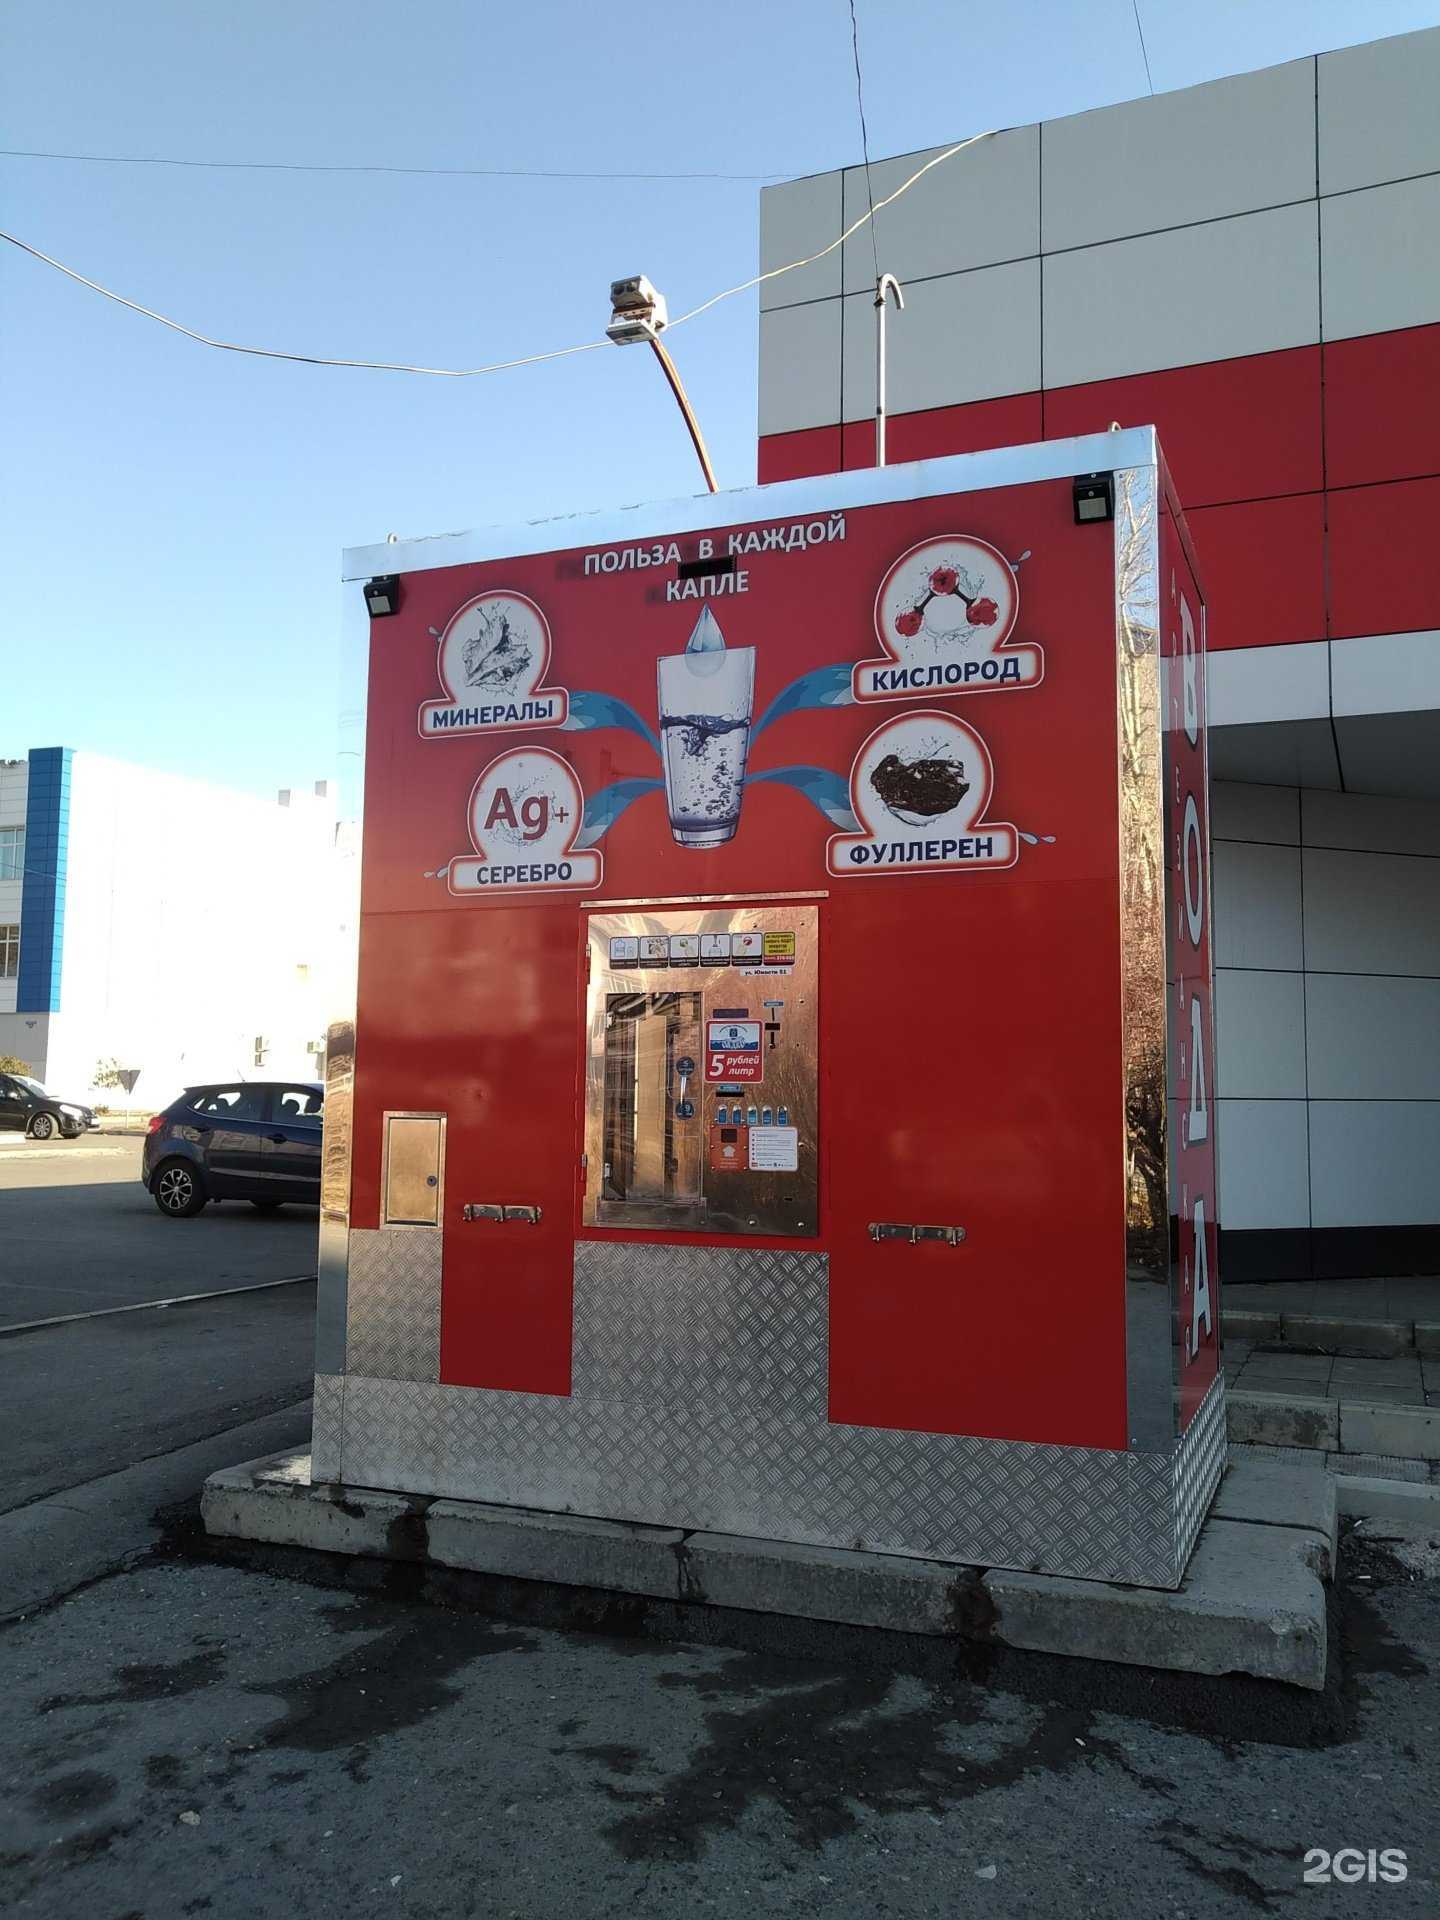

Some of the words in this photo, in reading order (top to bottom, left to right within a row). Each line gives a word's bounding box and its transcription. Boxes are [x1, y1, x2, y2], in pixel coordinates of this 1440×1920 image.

[584, 542, 682, 575] ПОЛЬЗА
[699, 538, 714, 560] В
[728, 512, 846, 556] КАЖДОЙ
[666, 571, 749, 602] КАПЛЕ
[872, 657, 1021, 691] КИСЛОРОД
[432, 700, 553, 728] МИНЕРАЛЫ
[850, 837, 993, 864] ФУЛЛЕРЕН
[477, 862, 572, 885] СЕРЕБРО
[1180, 591, 1212, 1358] ВОДА
[709, 1054, 725, 1077] 5
[726, 1055, 760, 1066] рублей
[728, 1067, 755, 1077] литр
